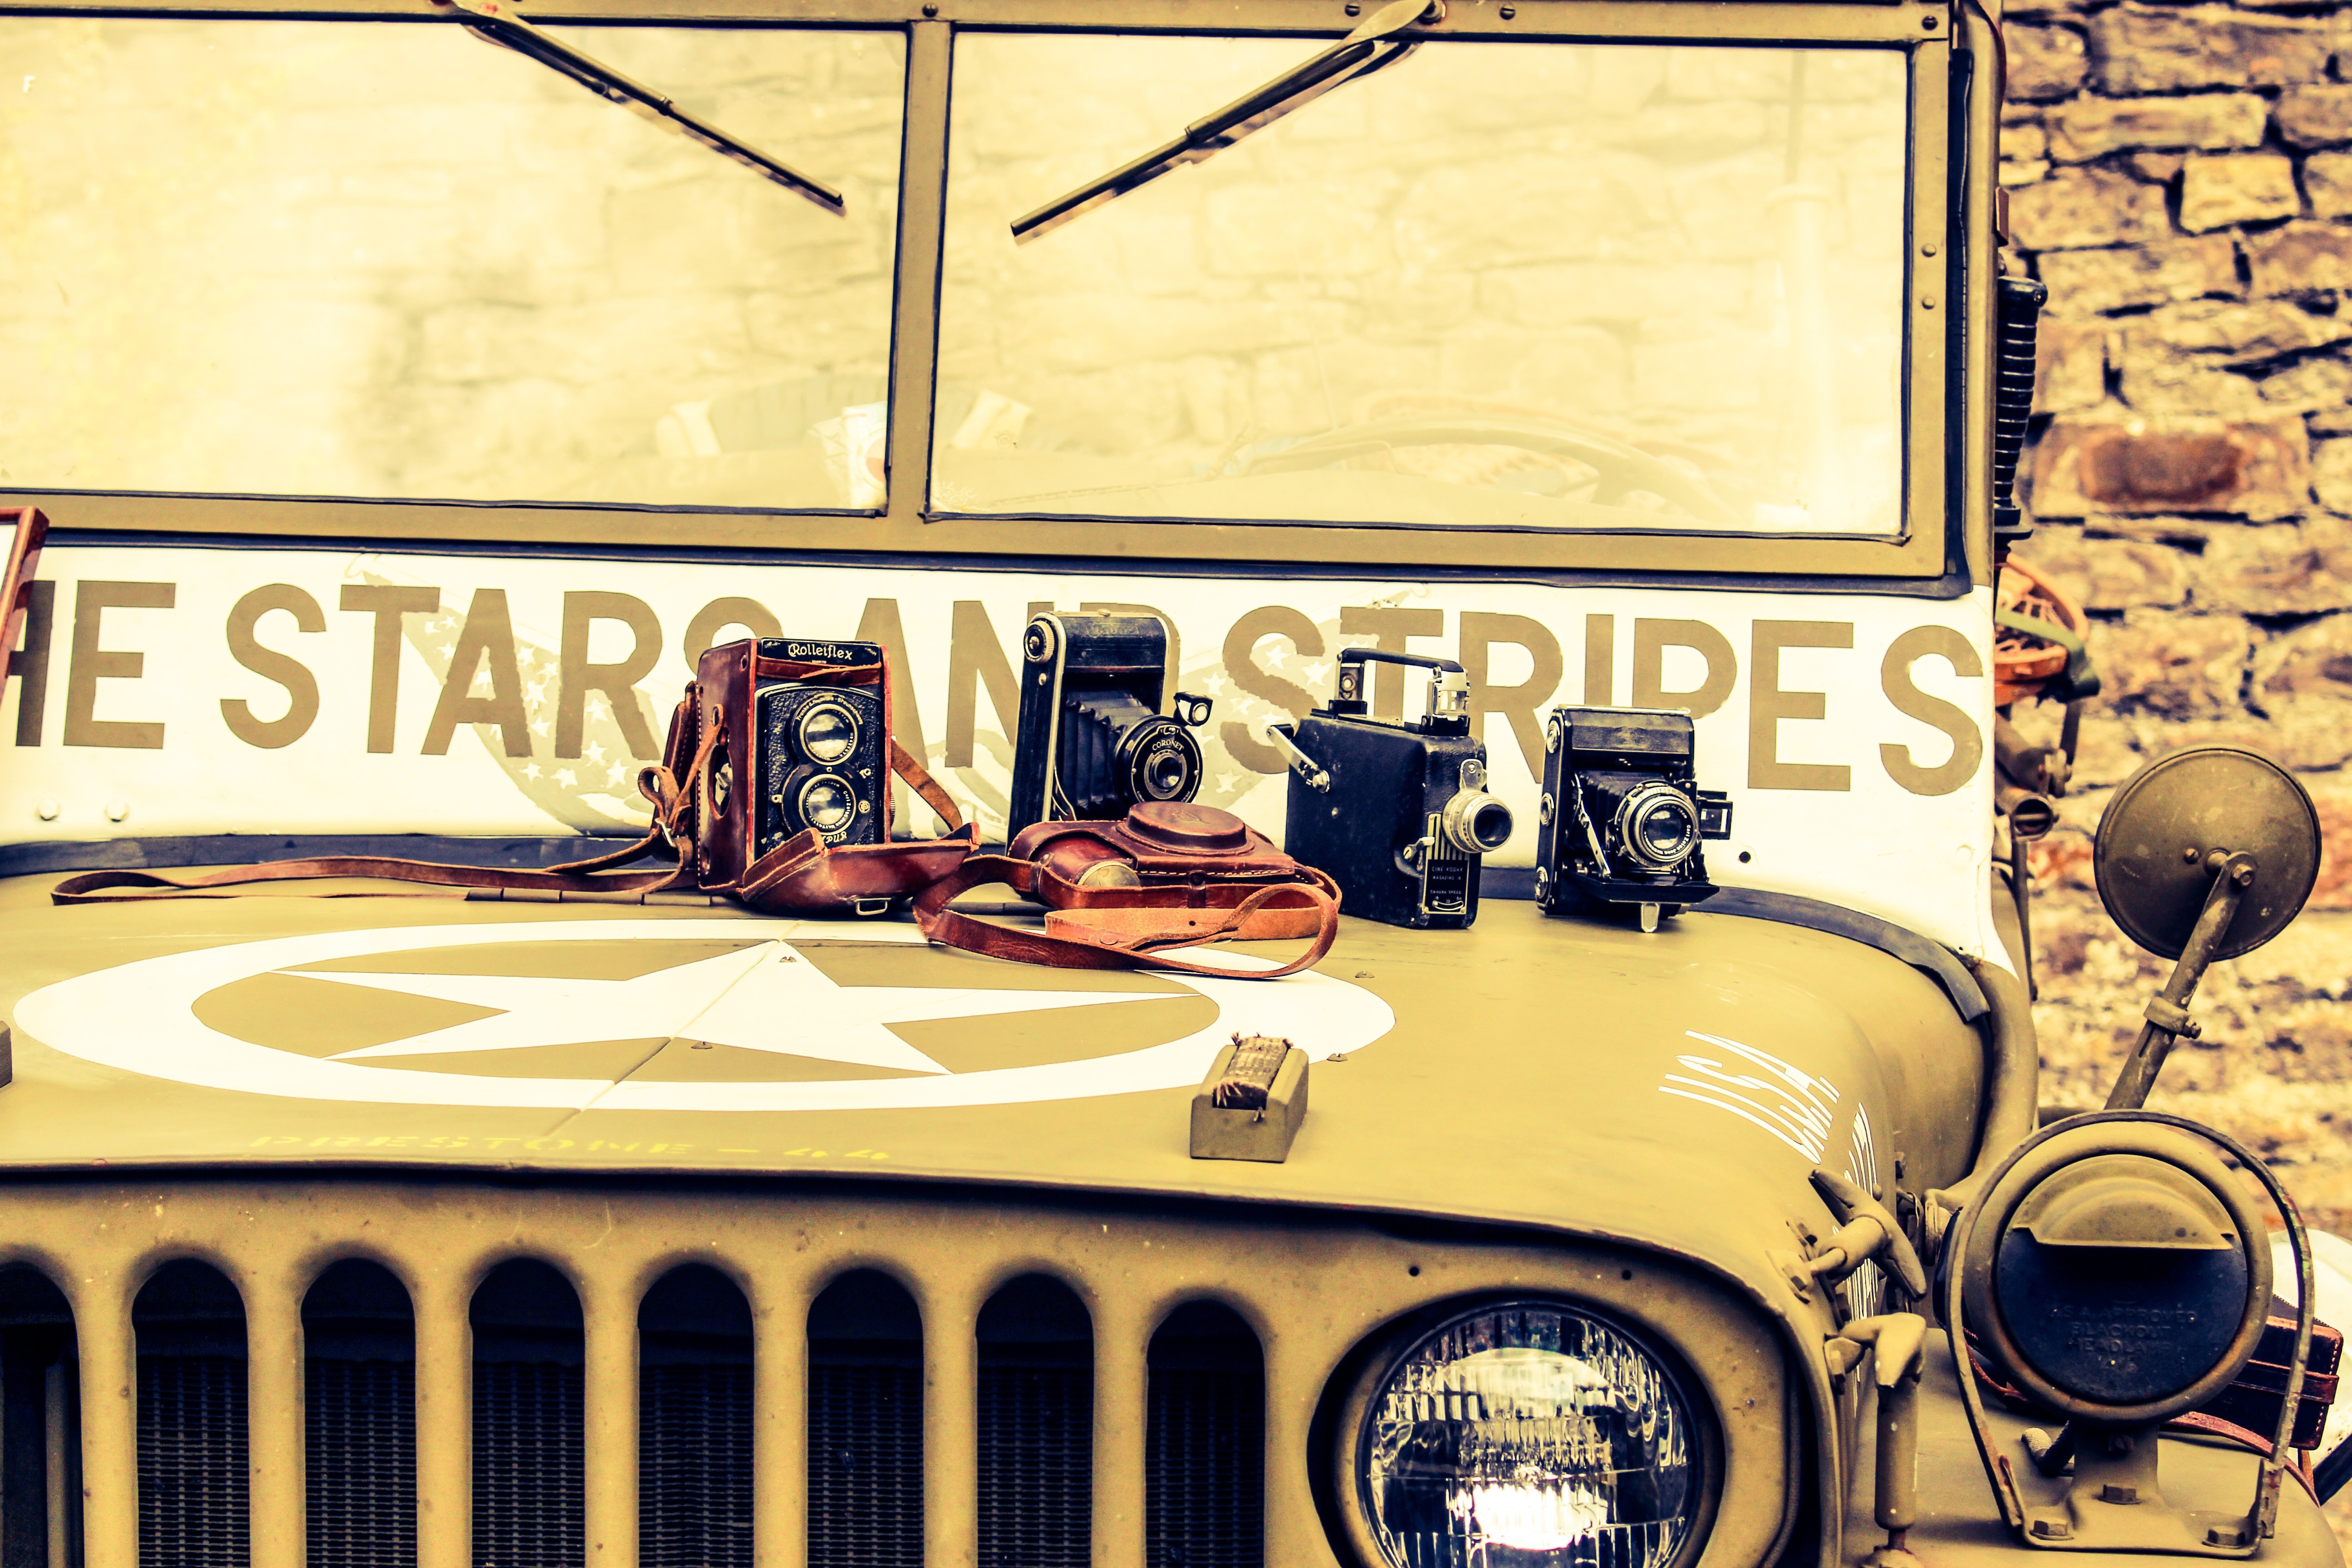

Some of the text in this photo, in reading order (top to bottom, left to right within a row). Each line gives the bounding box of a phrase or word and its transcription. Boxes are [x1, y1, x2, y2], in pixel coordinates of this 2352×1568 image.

[788, 643, 853, 660] Rolleiflex
[1220, 605, 1983, 796] STRIPES
[1152, 740, 1184, 751] CORONET
[249, 1136, 695, 1154] PRESTONE
[2071, 1321, 2171, 1338] BLACKOUT
